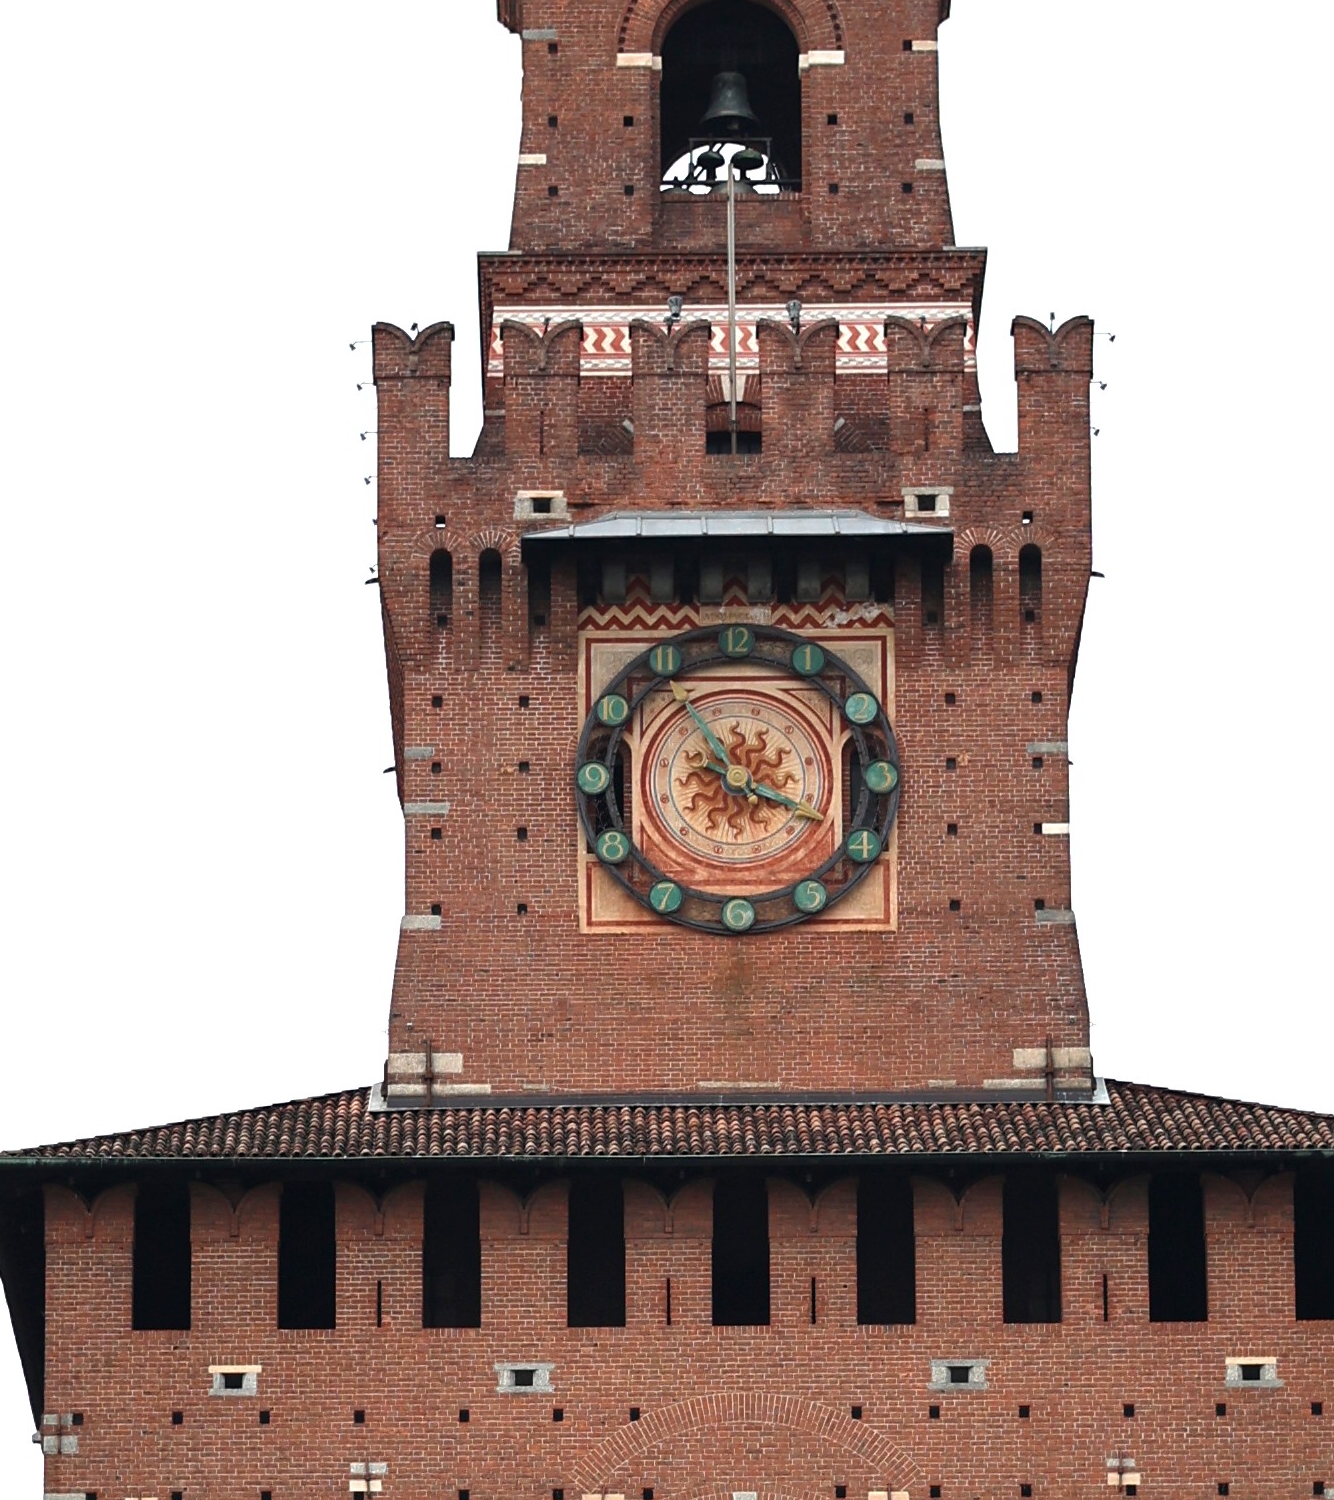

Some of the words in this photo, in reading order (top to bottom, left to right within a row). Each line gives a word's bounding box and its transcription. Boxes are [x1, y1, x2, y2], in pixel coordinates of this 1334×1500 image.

[725, 627, 749, 653] 12
[655, 646, 675, 672] 11
[804, 645, 812, 670] 1
[602, 697, 628, 723] 10
[856, 694, 870, 721] 2
[586, 766, 608, 791] 9
[878, 762, 893, 790] 3
[605, 834, 625, 860] 8
[849, 831, 873, 860] 4
[657, 884, 674, 911] 7
[806, 884, 823, 911] 5
[727, 902, 749, 926] 6
